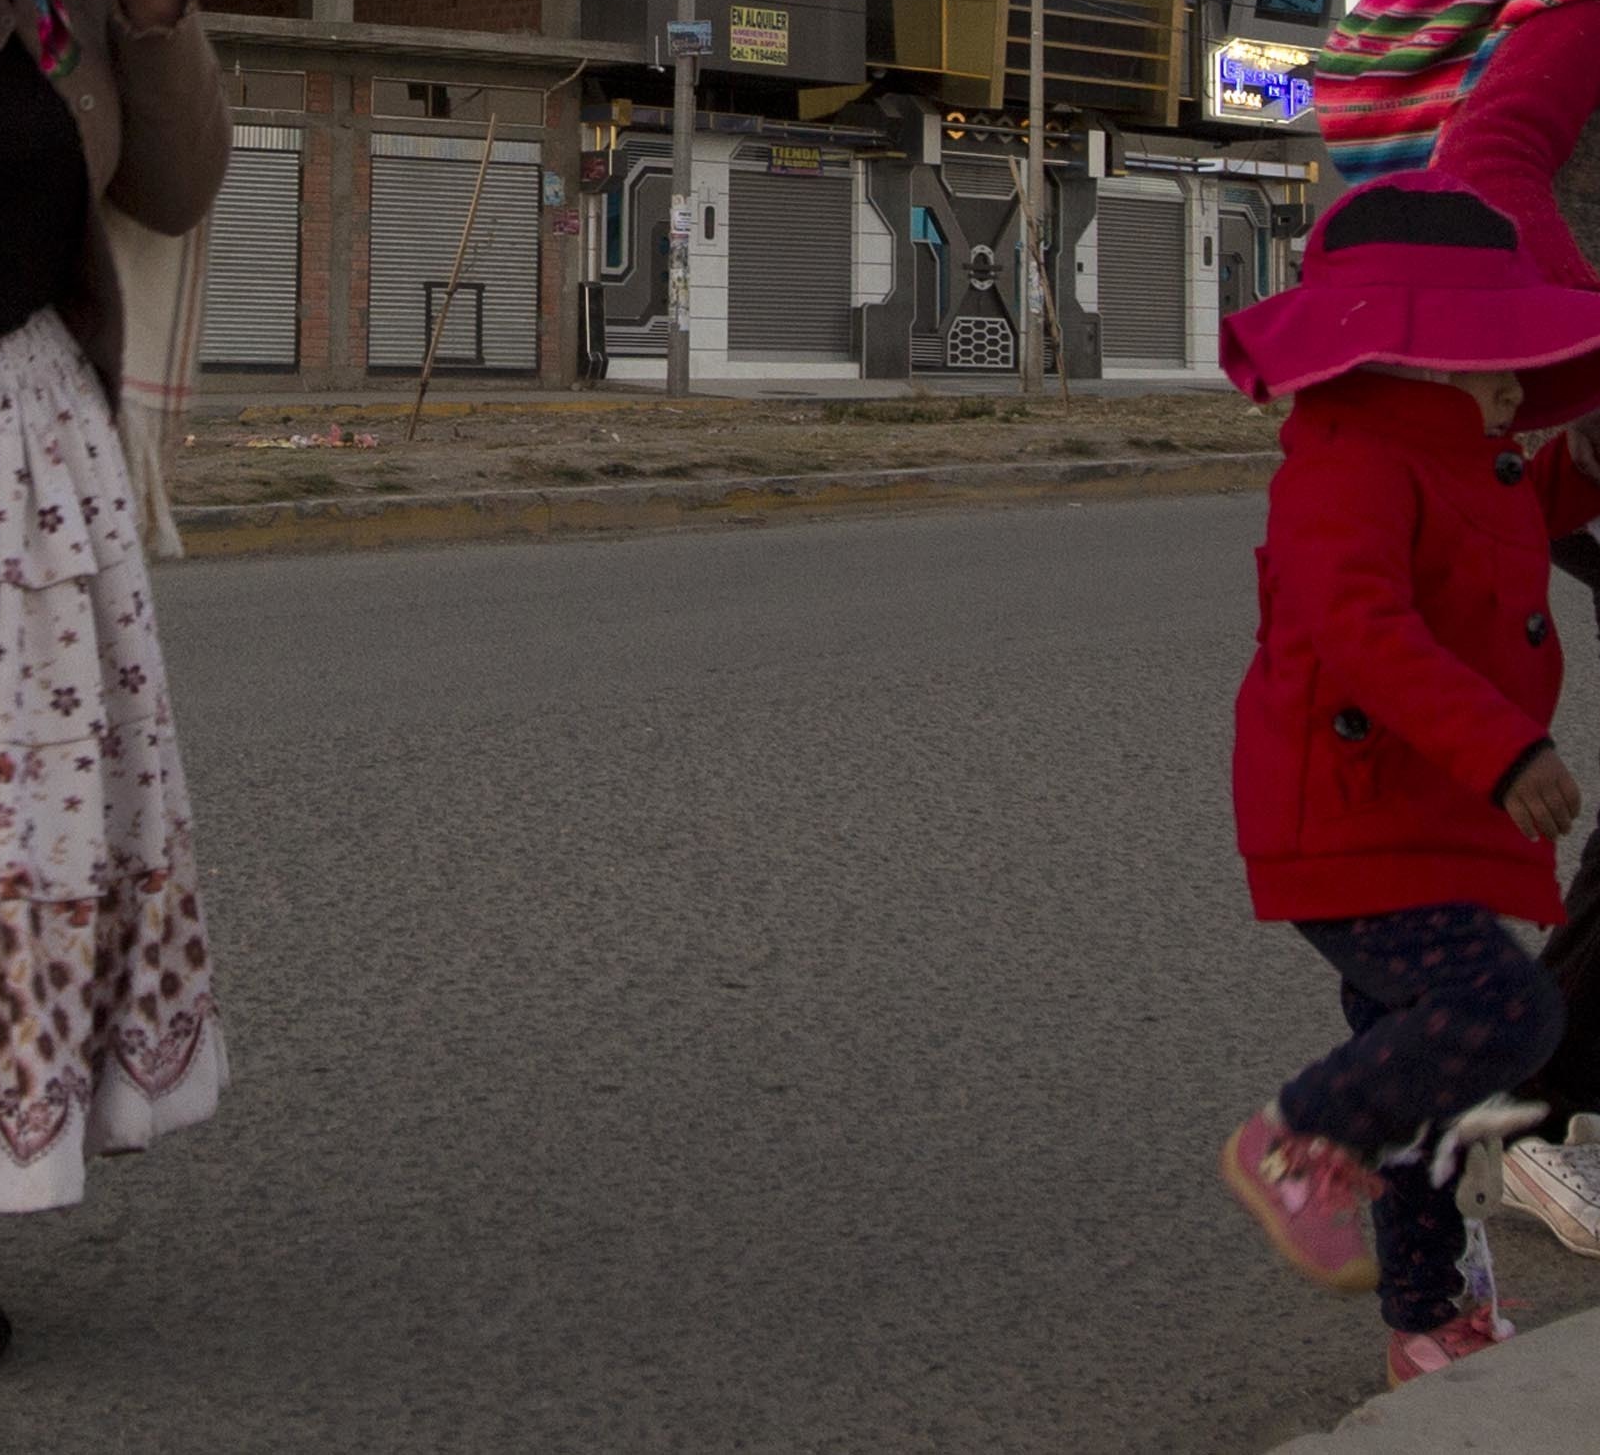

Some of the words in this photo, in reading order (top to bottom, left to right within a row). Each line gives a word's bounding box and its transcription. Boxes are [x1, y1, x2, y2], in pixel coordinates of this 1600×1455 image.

[732, 8, 744, 26] EN
[746, 9, 787, 30] ALQUILER
[772, 146, 820, 161] TIENDA
